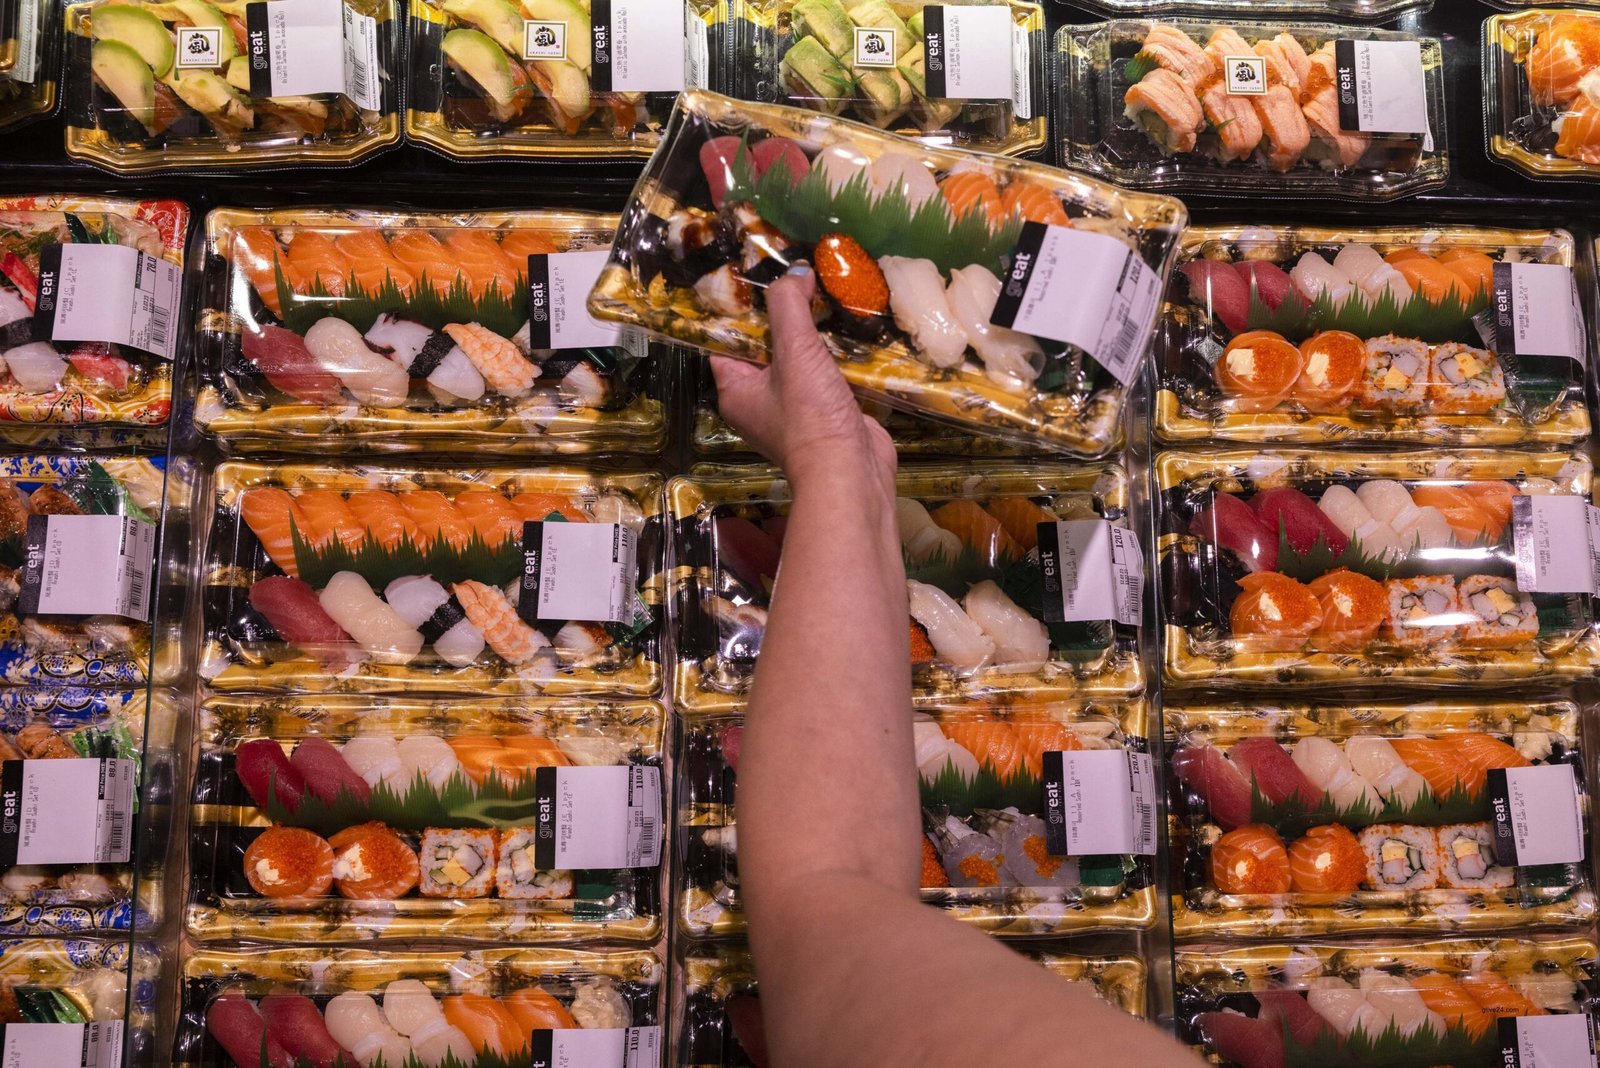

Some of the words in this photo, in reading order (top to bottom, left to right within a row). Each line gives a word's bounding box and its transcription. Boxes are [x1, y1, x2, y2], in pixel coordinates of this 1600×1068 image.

[250, 31, 268, 69] great
[592, 25, 610, 64] great
[926, 32, 942, 70] great
[1338, 66, 1355, 104] great
[146, 256, 156, 272] 78.0
[1006, 252, 1031, 298] great
[40, 272, 54, 310] great
[532, 282, 548, 322] great
[1496, 290, 1511, 326] great
[130, 520, 138, 536] 88.0
[1114, 528, 1123, 548] 120.0
[25, 544, 40, 584] great
[524, 550, 537, 590] great
[1042, 552, 1058, 592] great
[108, 760, 116, 778] 88.0
[1132, 754, 1140, 774] 120.0
[2, 791, 16, 834] great
[538, 796, 552, 838] great
[1046, 782, 1063, 824] great
[1492, 798, 1511, 838] great
[91, 1025, 99, 1042] 88.0
[630, 1030, 639, 1051] 110.0
